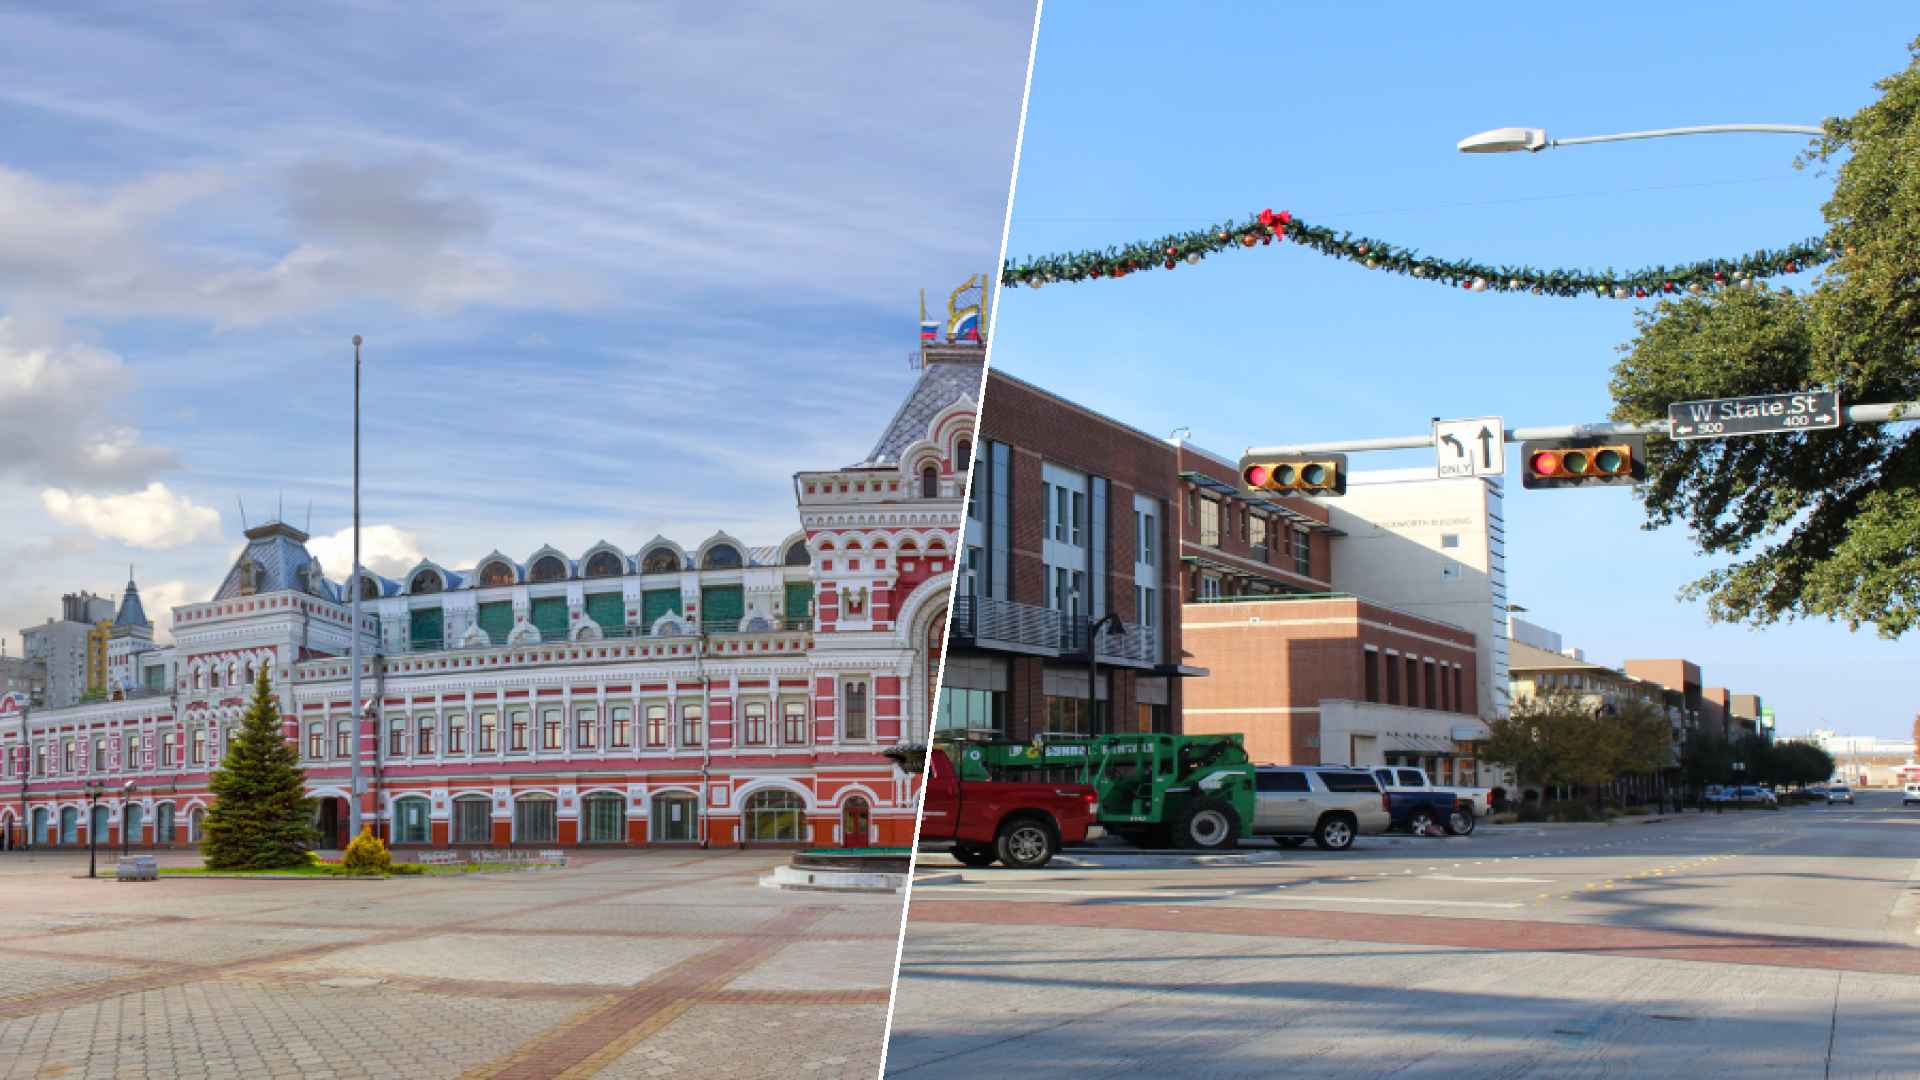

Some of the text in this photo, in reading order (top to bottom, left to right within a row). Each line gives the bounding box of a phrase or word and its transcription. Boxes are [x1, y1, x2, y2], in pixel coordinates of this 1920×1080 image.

[1690, 395, 1817, 422] W State St
[1783, 415, 1809, 427] 400
[1697, 422, 1725, 434] 500
[1440, 463, 1471, 475] ONLY
